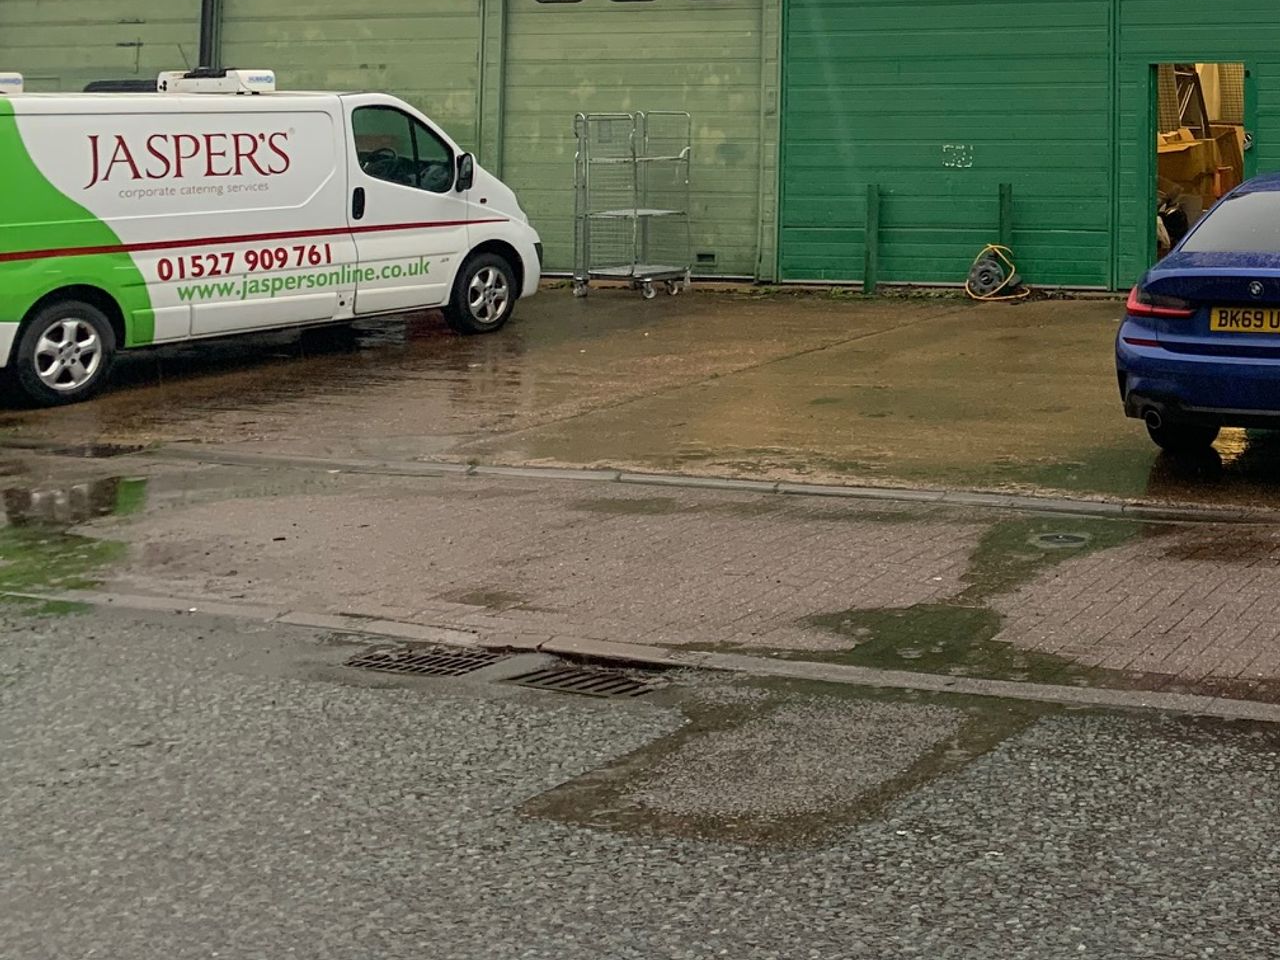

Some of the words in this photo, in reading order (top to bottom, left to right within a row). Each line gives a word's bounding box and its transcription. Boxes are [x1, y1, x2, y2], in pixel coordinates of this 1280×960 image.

[83, 132, 290, 190] JASPER'S
[118, 186, 176, 200] corporate
[180, 184, 224, 197] catering
[227, 182, 269, 194] services
[157, 252, 235, 281] 01527
[244, 247, 288, 272] 909
[293, 243, 332, 267] 761
[177, 255, 431, 301] www.jaspersonline.co.uk
[1218, 310, 1264, 328] BK69
